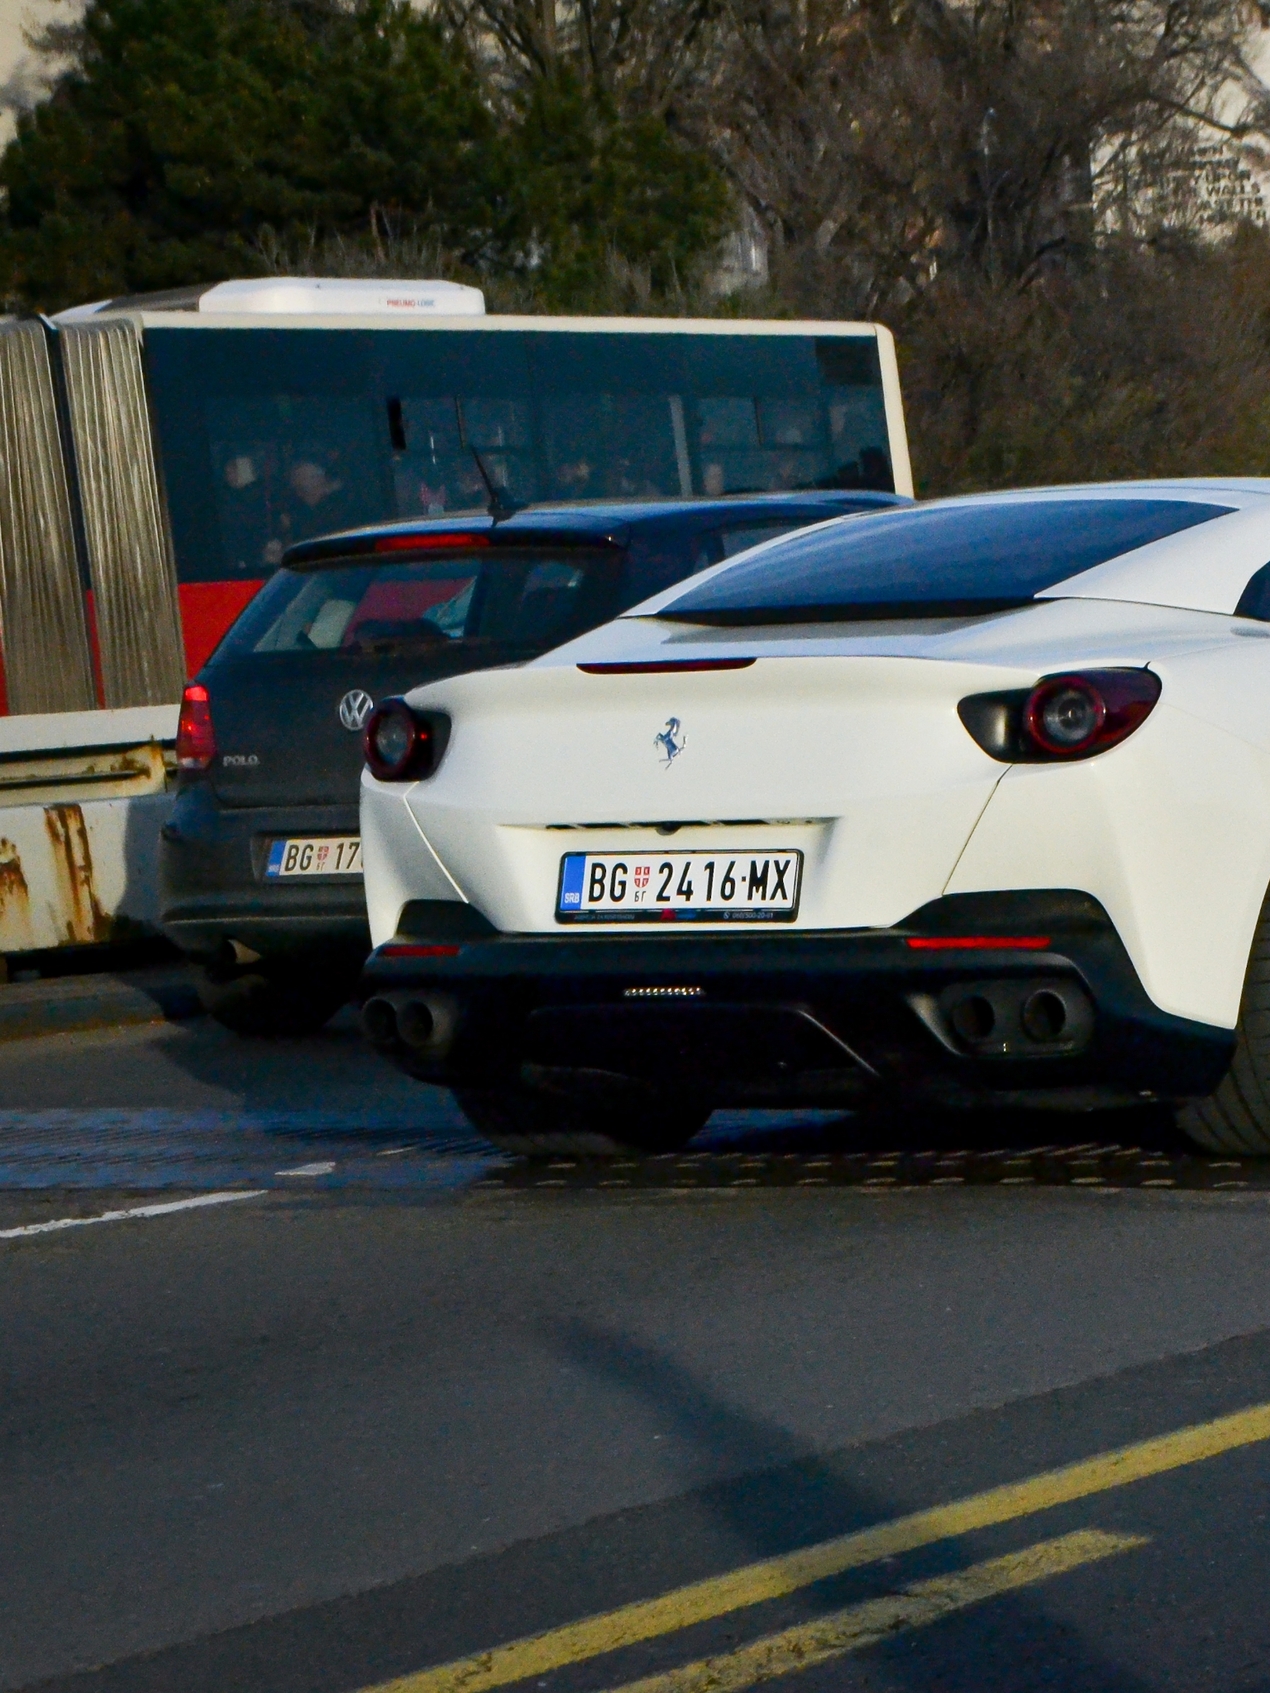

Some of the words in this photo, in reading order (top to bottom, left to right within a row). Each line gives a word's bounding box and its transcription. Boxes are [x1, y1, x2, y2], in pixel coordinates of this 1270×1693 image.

[223, 755, 259, 766] POLO
[284, 844, 314, 872] BG
[335, 842, 363, 869] 17
[588, 862, 629, 903] BG
[564, 893, 580, 904] SRB
